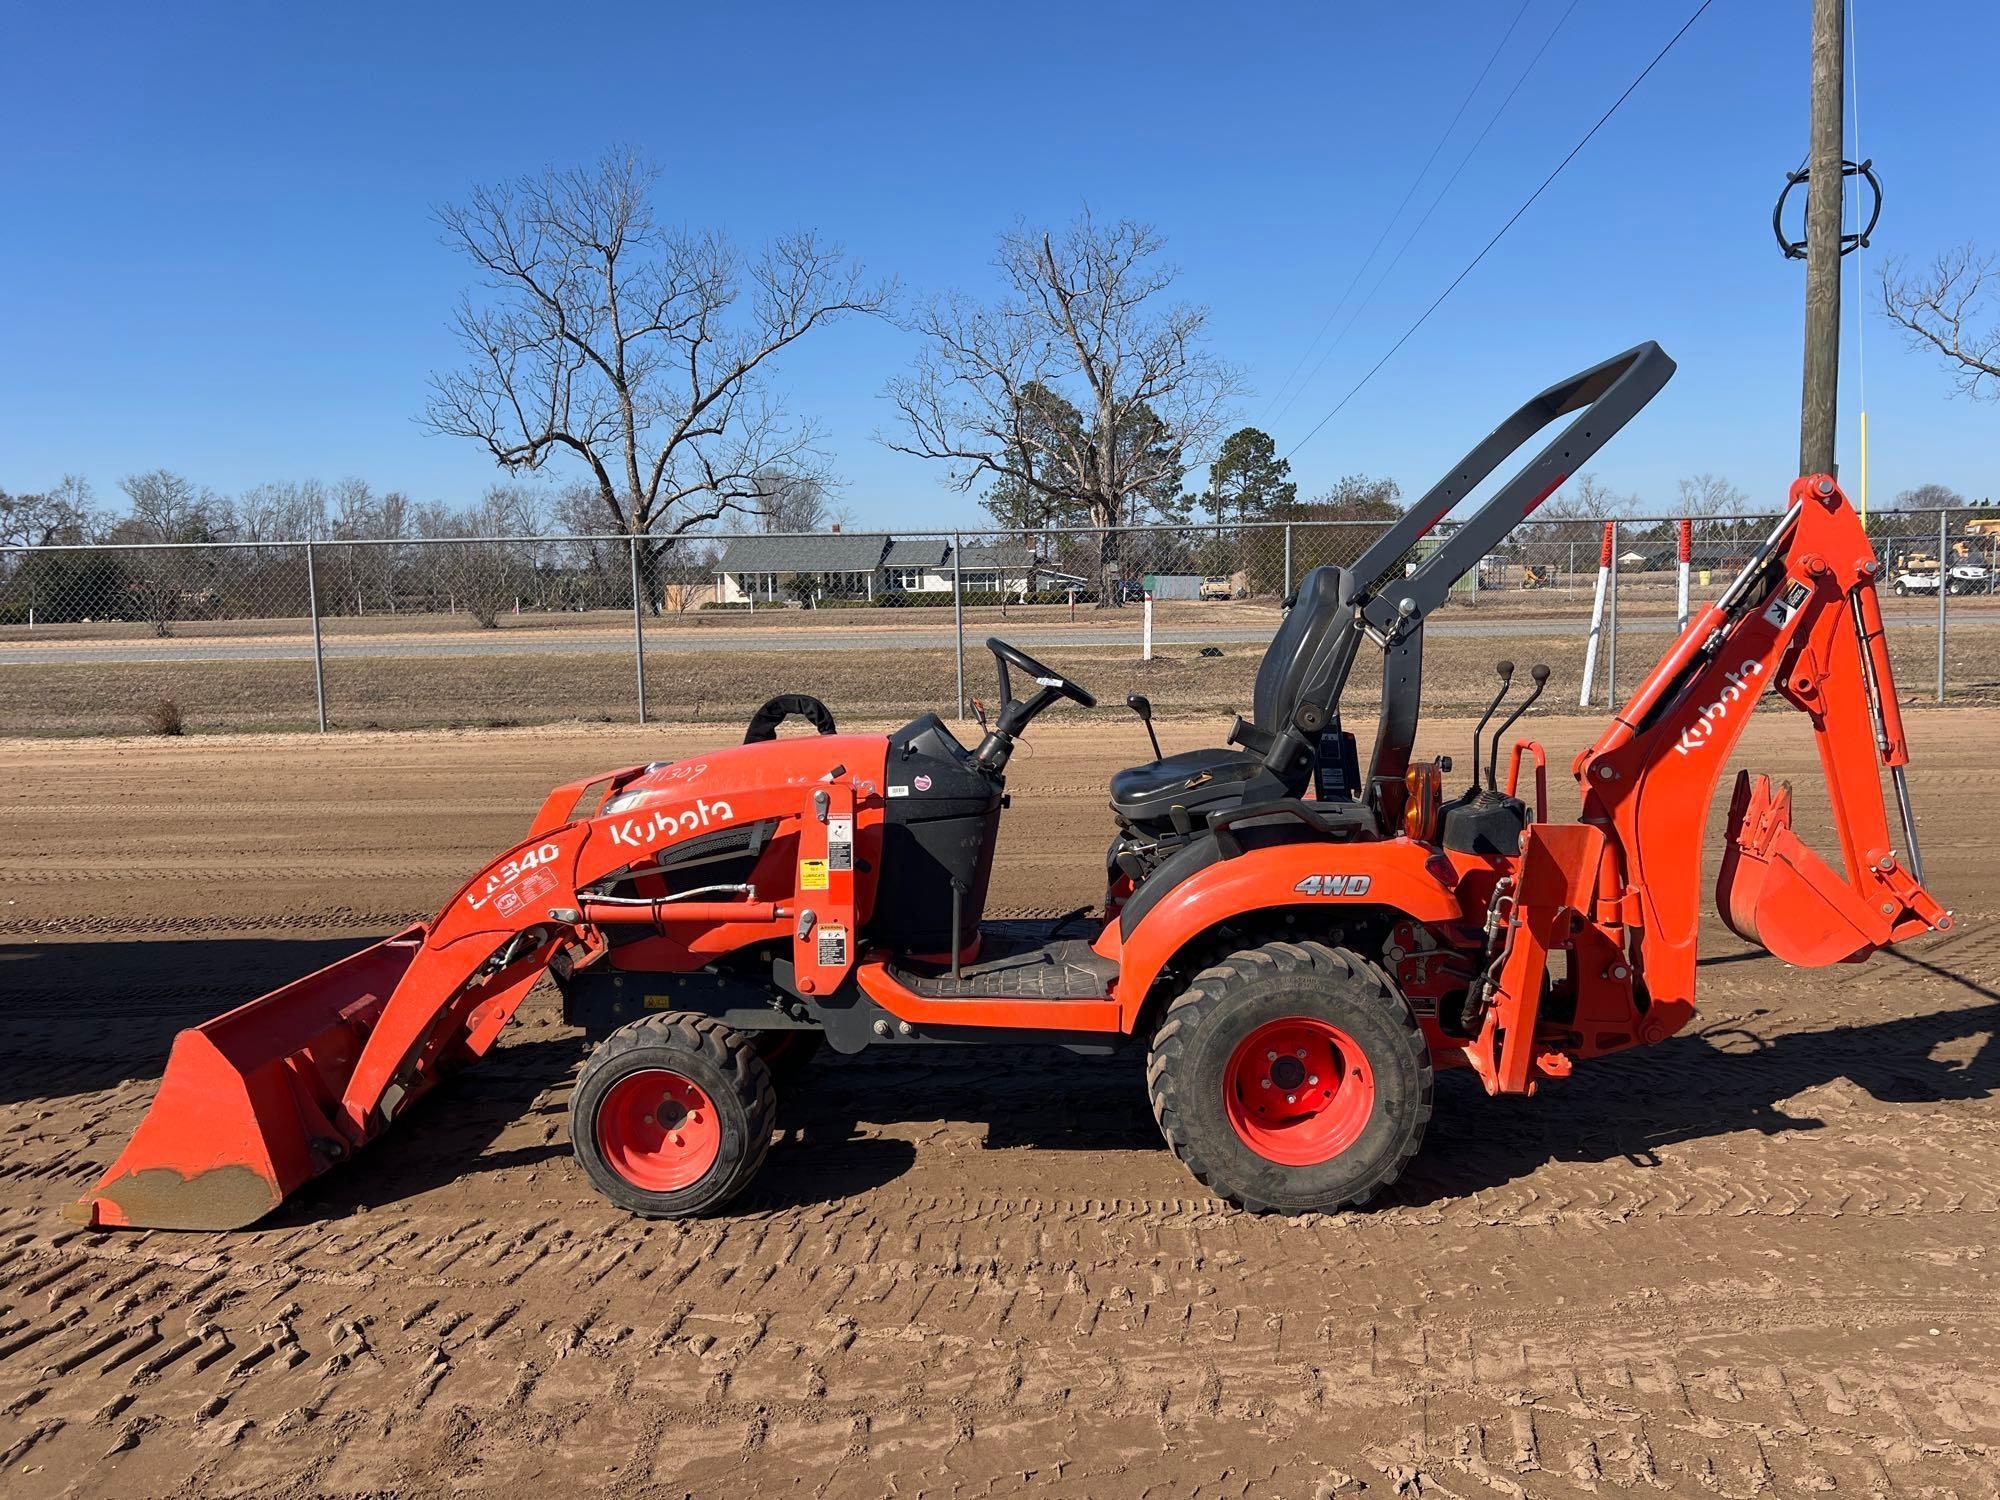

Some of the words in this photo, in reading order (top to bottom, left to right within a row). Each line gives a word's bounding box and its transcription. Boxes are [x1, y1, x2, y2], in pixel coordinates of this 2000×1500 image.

[1674, 659, 1764, 756] Kubota
[609, 799, 735, 847] Kubota
[466, 843, 560, 910] LA340
[1293, 874, 1372, 897] 4WD
